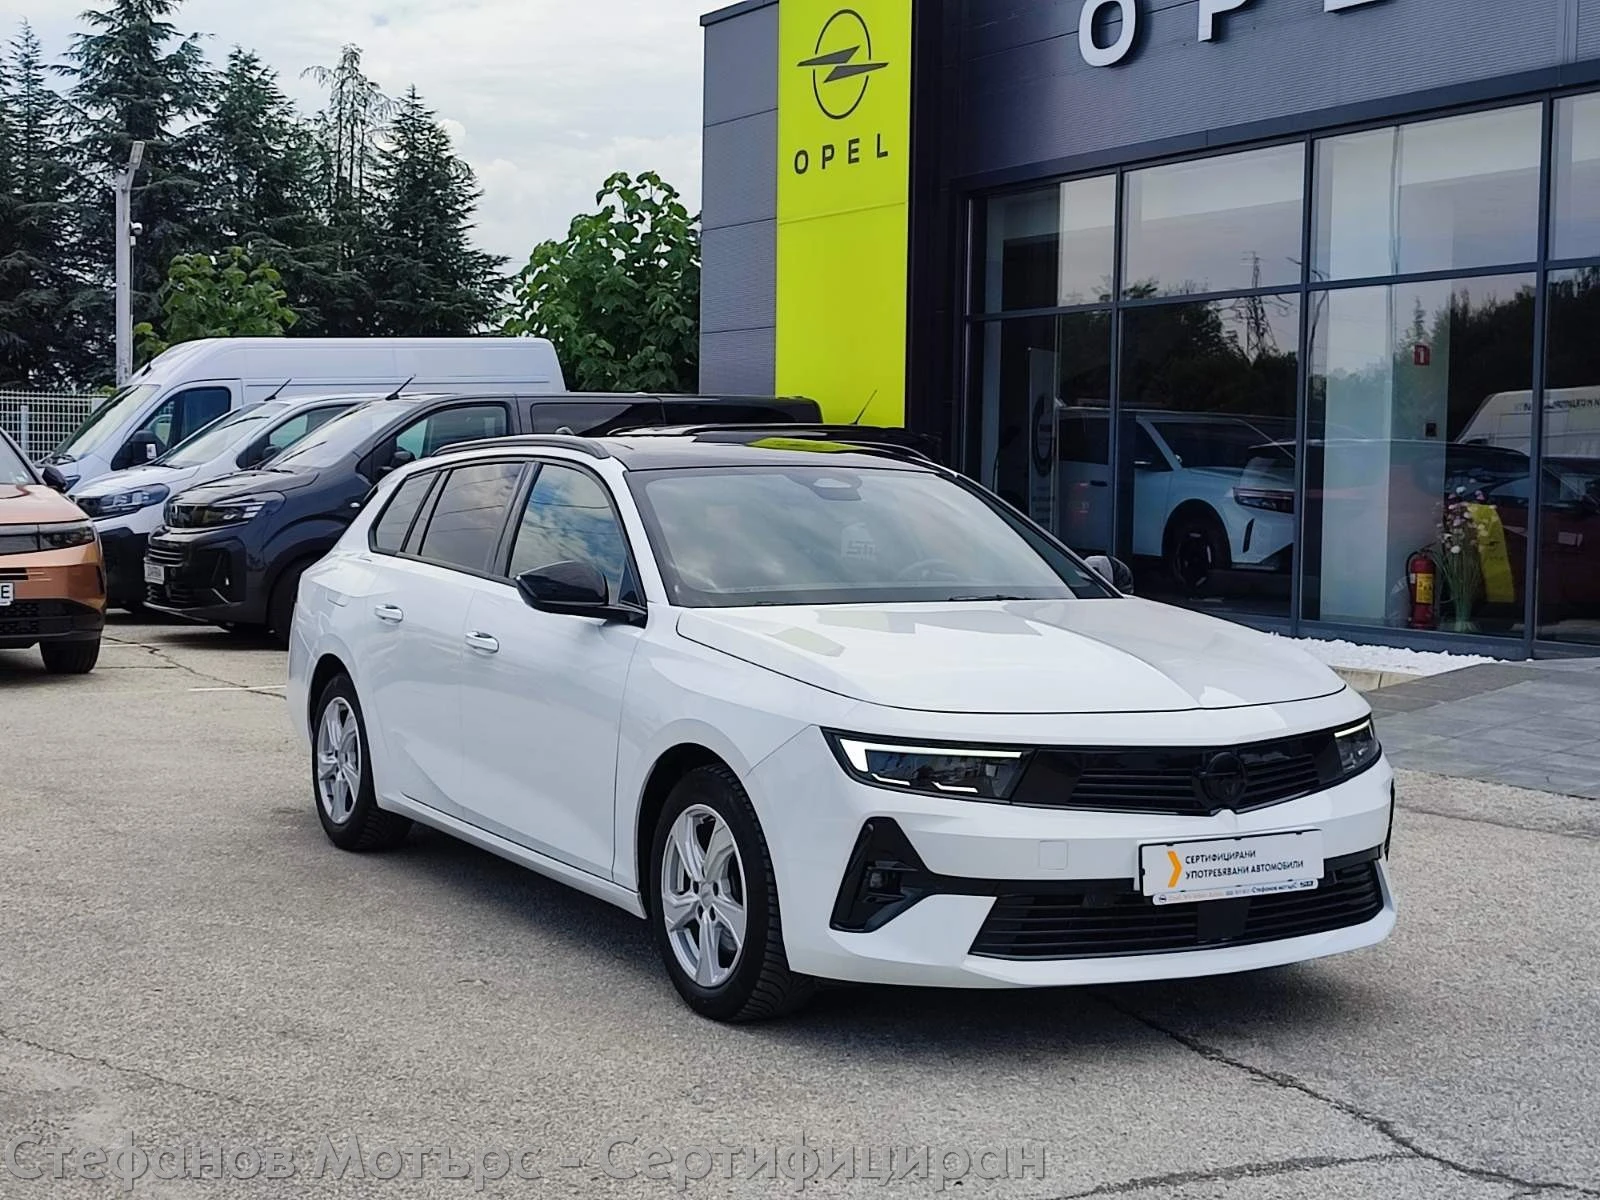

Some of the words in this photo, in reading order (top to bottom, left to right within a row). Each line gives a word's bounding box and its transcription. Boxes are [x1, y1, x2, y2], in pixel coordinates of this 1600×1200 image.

[794, 132, 889, 175] OPEL
[1184, 850, 1256, 865] СЕРТИФИЦИРАНИ
[1185, 866, 1250, 880] УПОТРЕБЯВАНИ
[1250, 860, 1304, 873] АВТОМОБИЛИ
